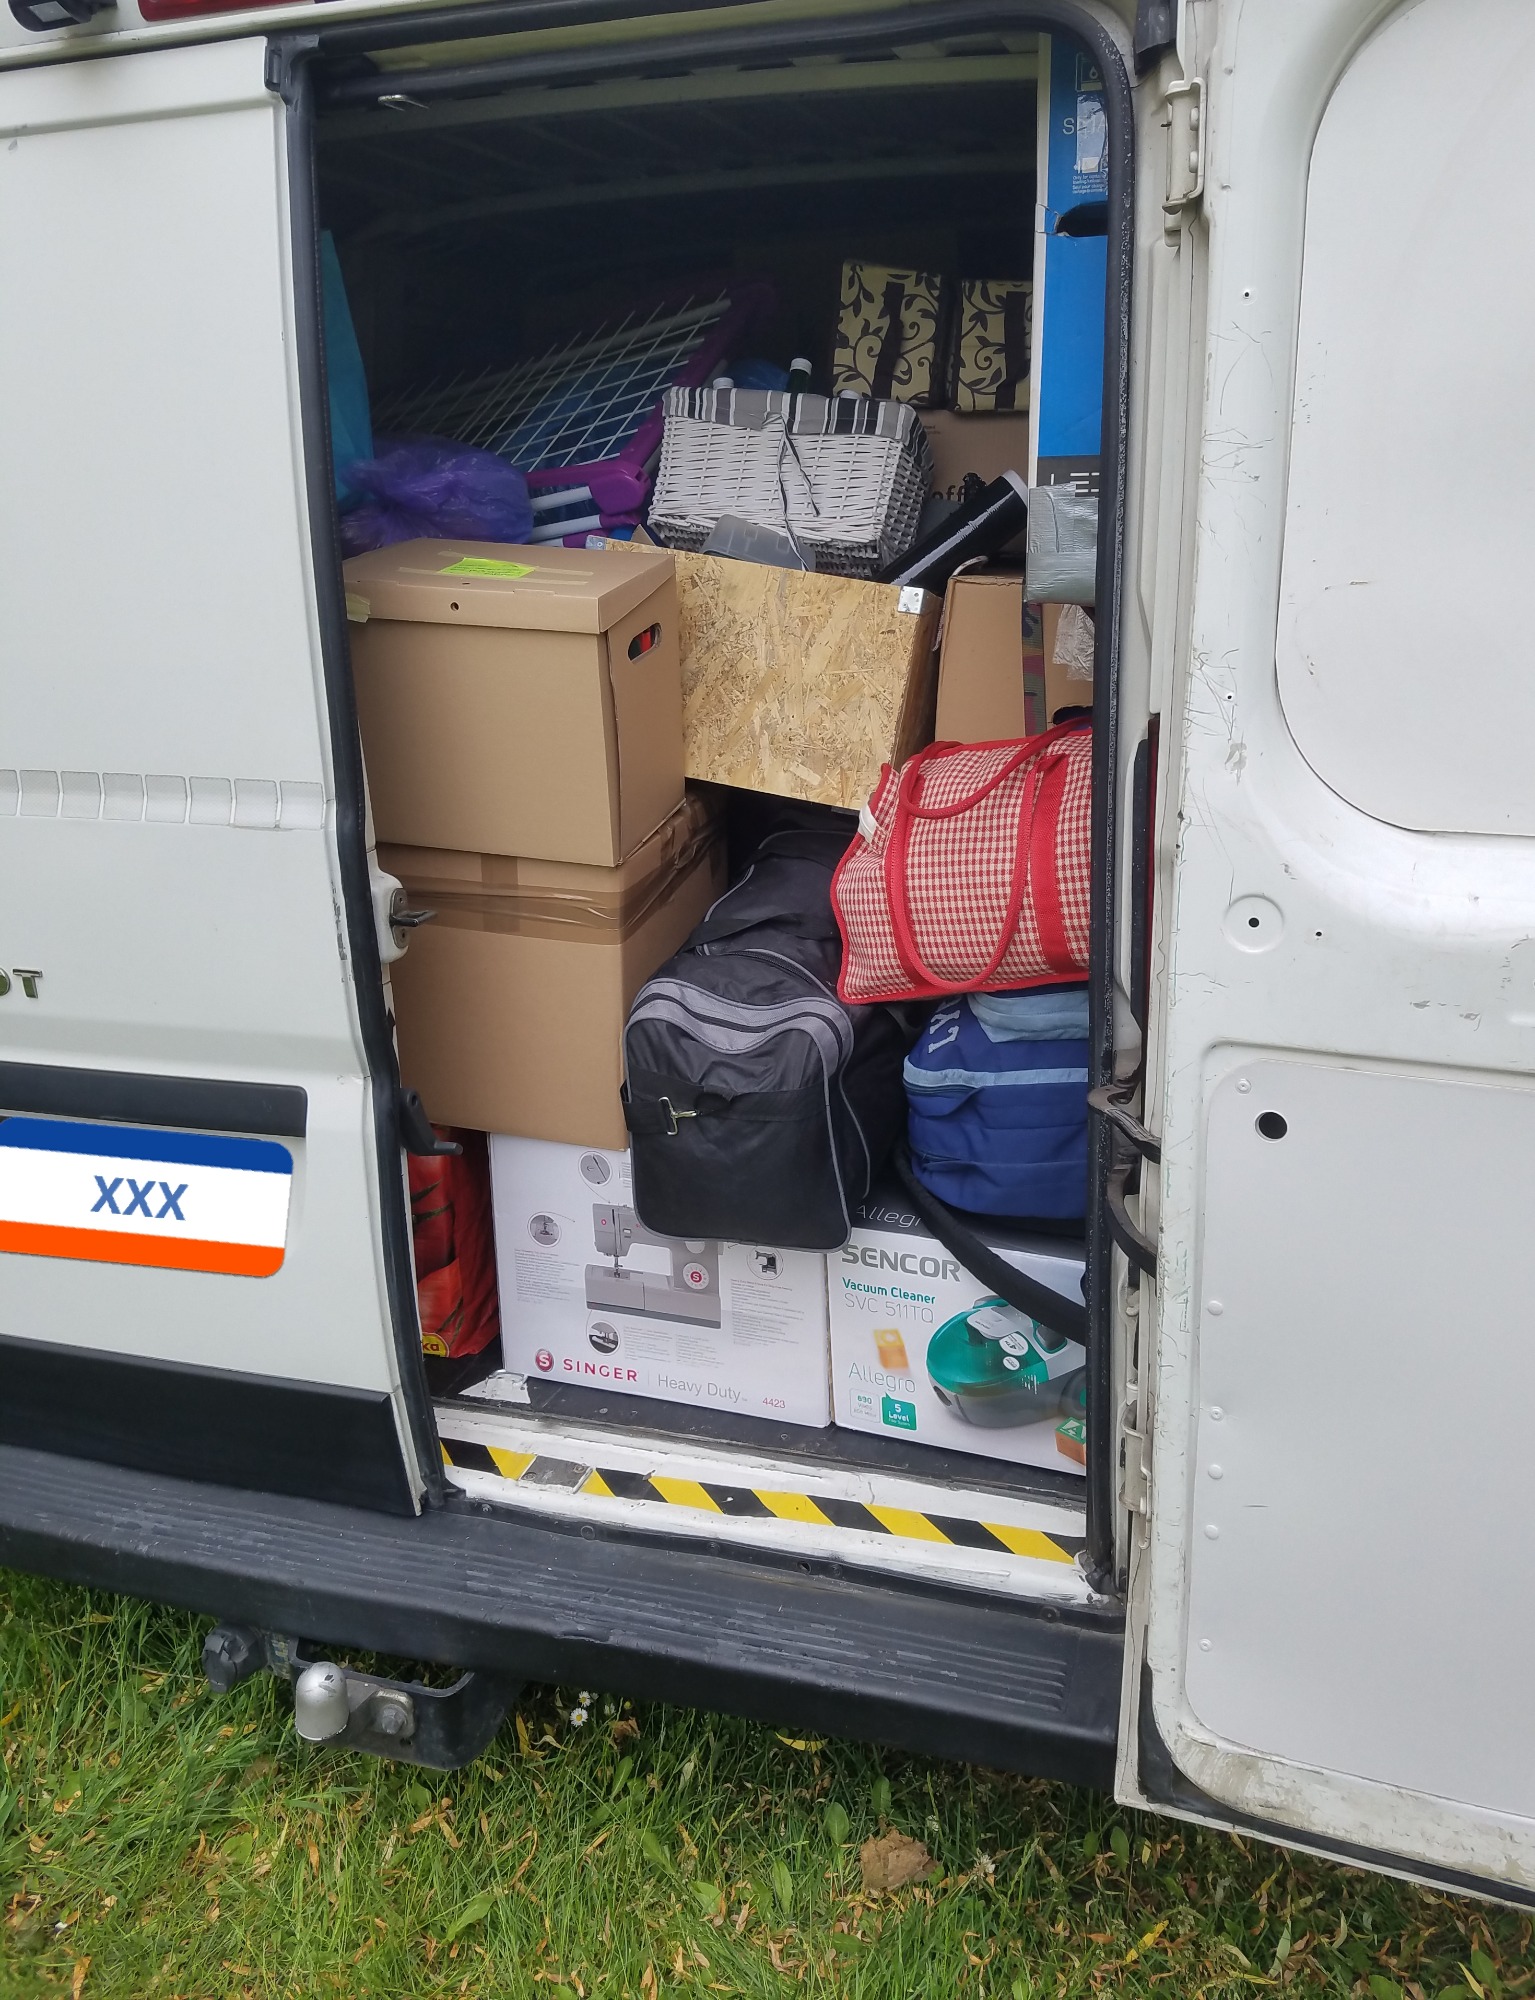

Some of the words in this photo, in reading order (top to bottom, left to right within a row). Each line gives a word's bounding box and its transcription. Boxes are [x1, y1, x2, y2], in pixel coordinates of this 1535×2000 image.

[841, 1243, 961, 1283] SENCOR
[842, 1276, 888, 1296] Vacuum
[890, 1286, 936, 1304] Cleaner
[844, 1292, 878, 1313] SVC
[563, 1358, 637, 1382] SINGER
[658, 1373, 702, 1397] Heavy
[707, 1382, 741, 1404] Duty
[762, 1397, 786, 1409] 4423
[848, 1362, 916, 1393] Allegro
[888, 1410, 910, 1423] Level
[894, 1403, 902, 1413] 5
